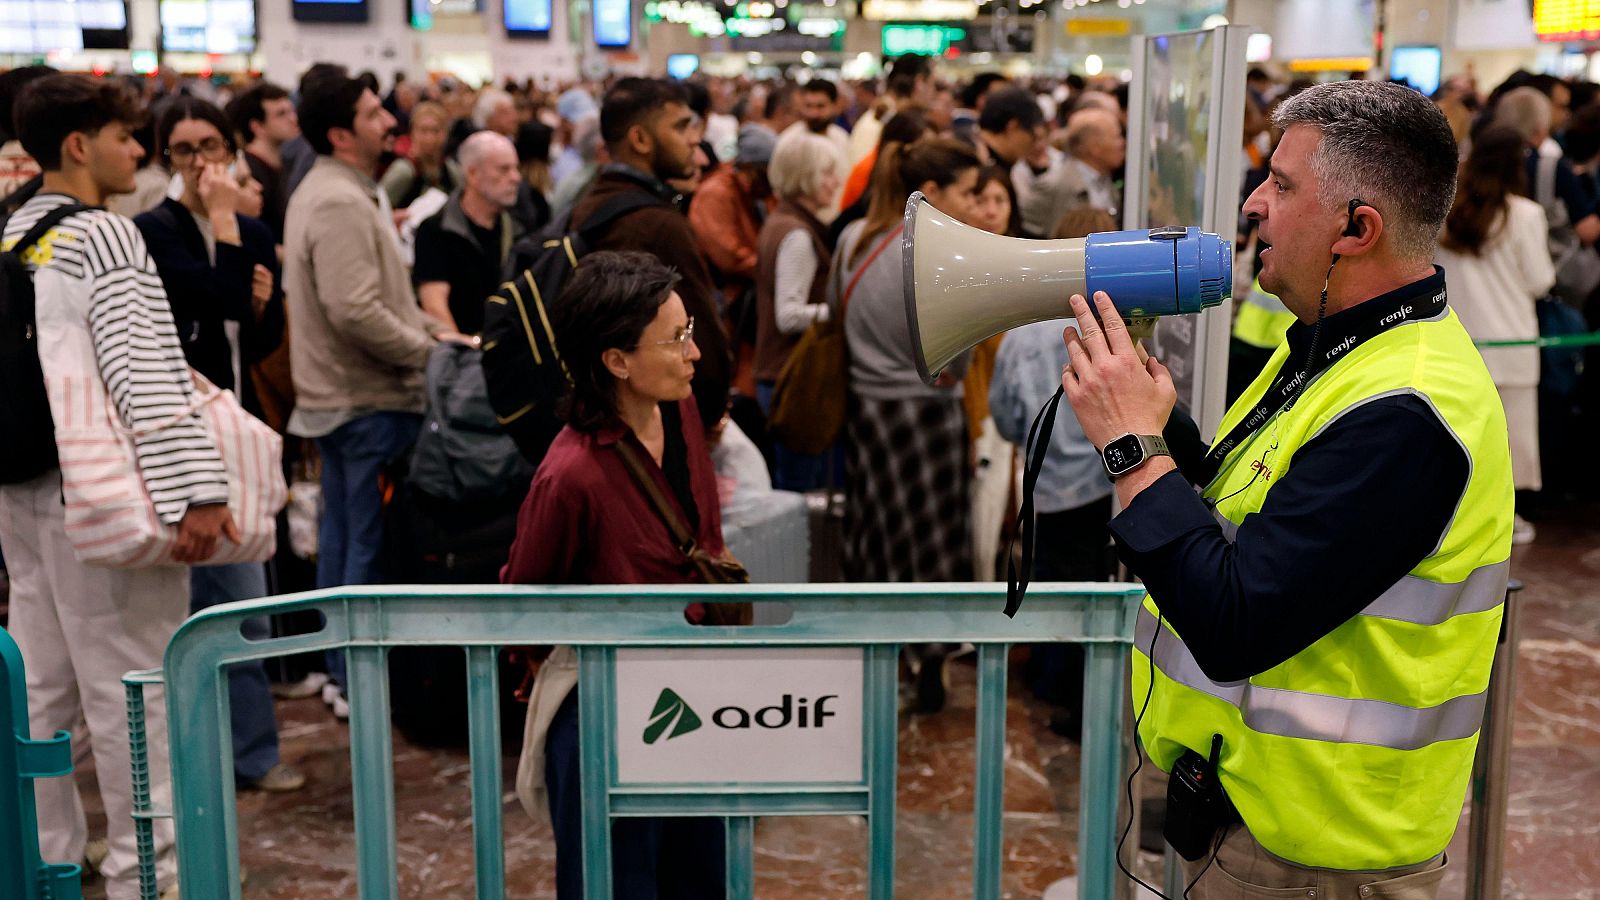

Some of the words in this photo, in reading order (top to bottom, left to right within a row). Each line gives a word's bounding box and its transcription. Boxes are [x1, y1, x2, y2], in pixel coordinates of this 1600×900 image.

[1380, 304, 1413, 326] renfe
[1325, 335, 1357, 360] renfe
[1245, 406, 1269, 429] renfe
[1214, 439, 1235, 460] renfe
[712, 694, 839, 729] adif
